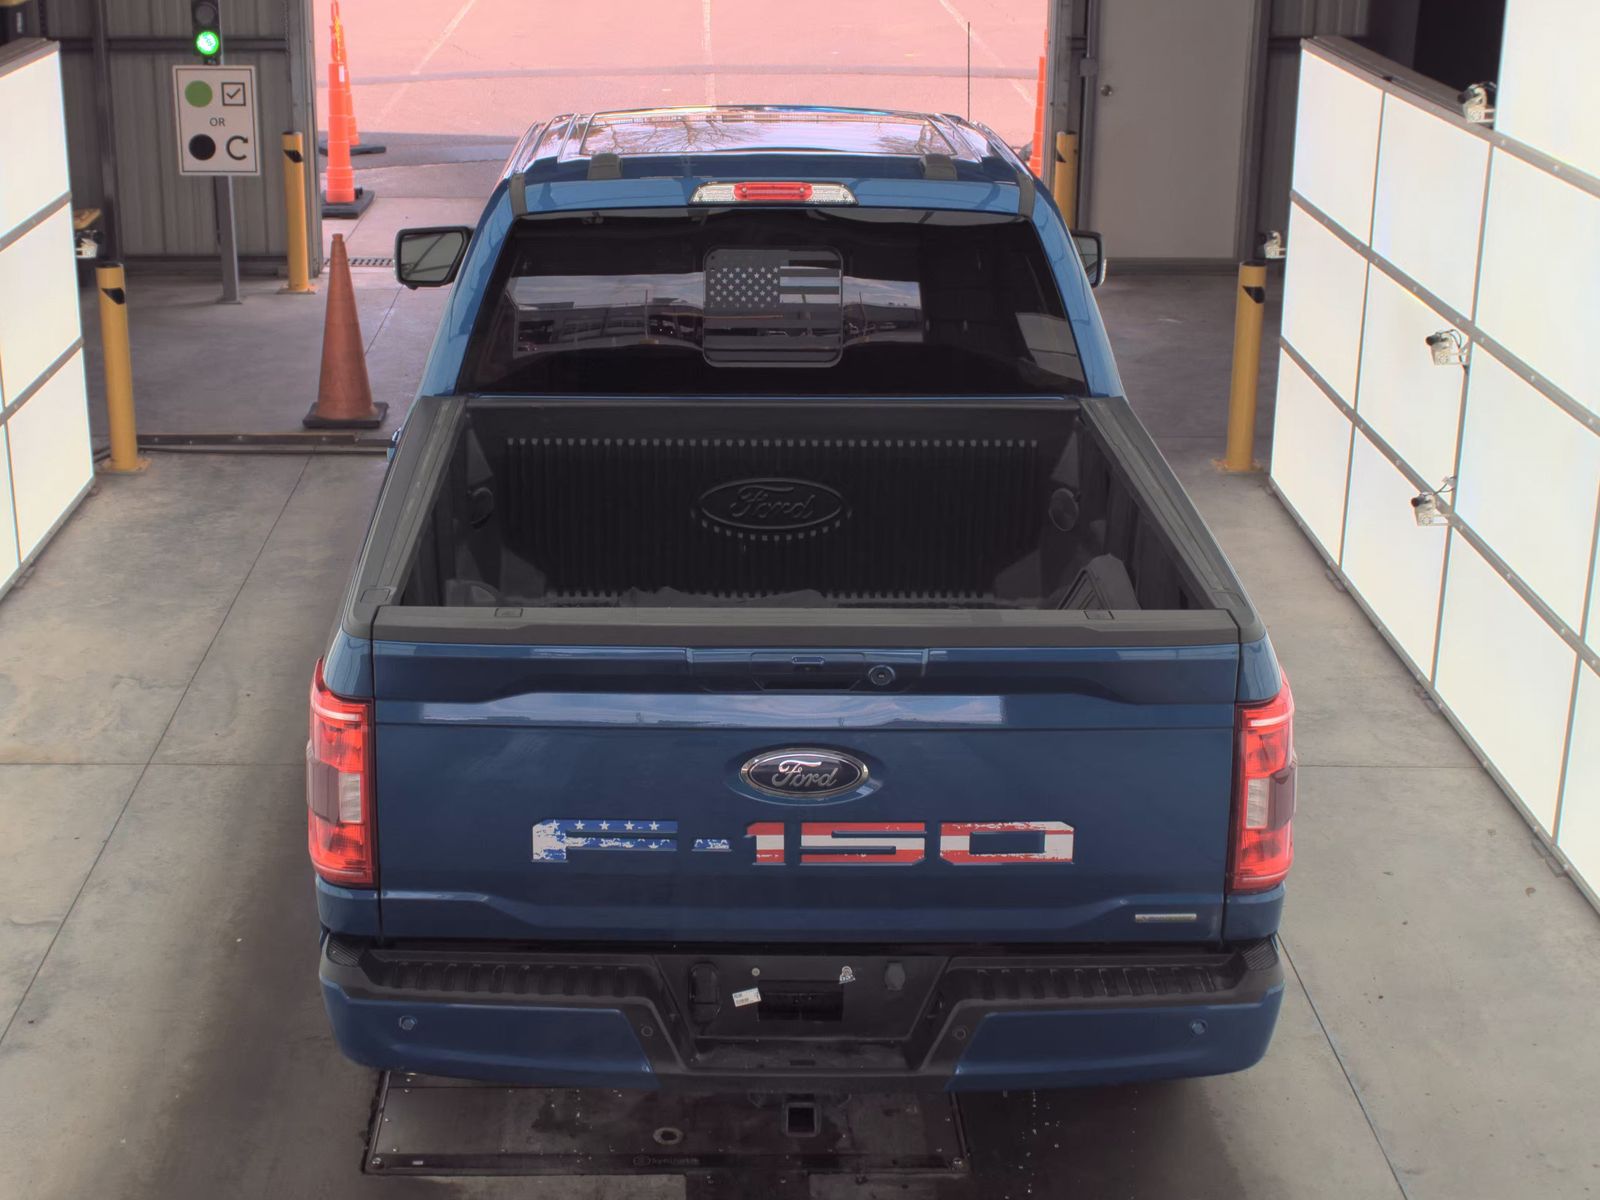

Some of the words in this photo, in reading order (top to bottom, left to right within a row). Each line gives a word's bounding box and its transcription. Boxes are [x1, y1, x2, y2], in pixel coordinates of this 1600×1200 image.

[209, 117, 225, 127] OR
[730, 485, 816, 519] Ford
[771, 759, 838, 787] Ford
[531, 819, 1075, 866] F-150
